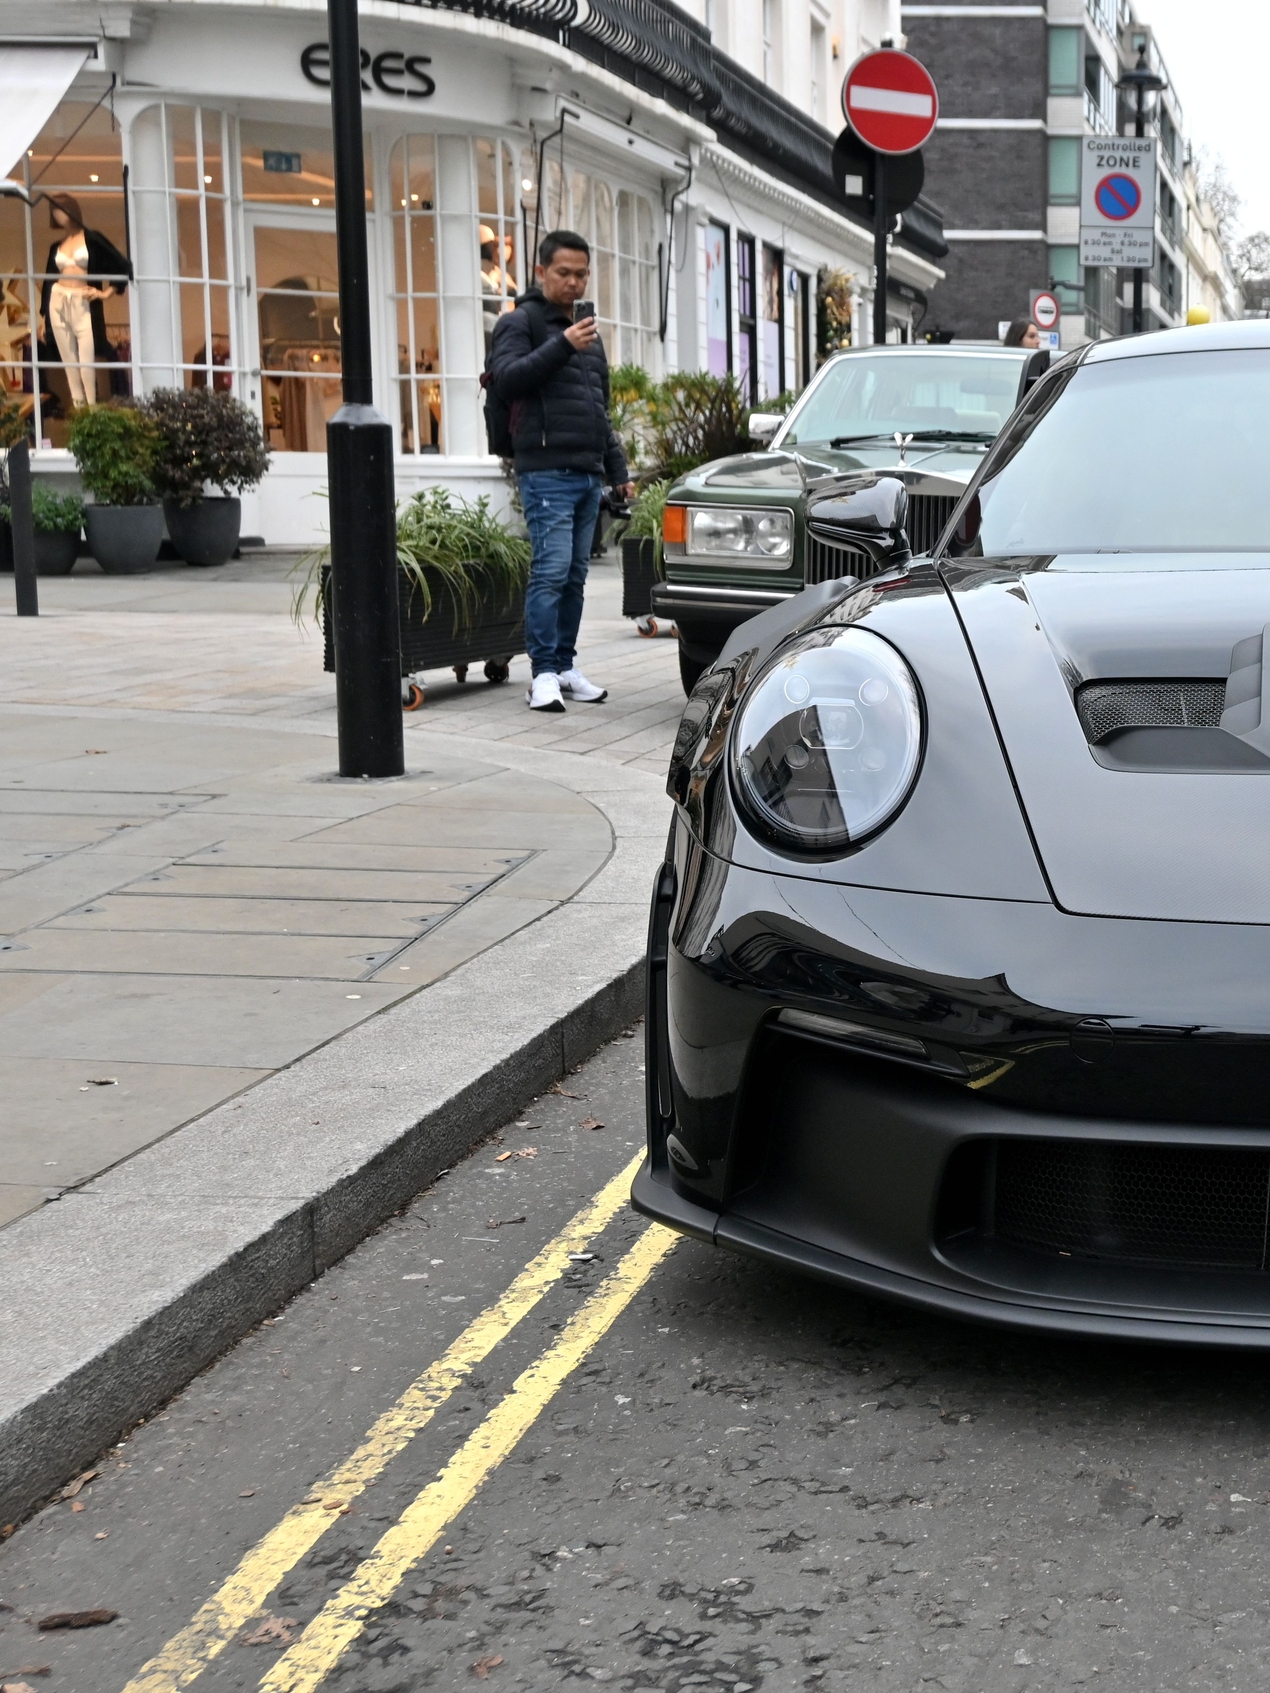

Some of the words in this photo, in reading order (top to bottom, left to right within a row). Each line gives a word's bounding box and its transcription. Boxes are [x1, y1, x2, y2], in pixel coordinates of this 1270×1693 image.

[1087, 140, 1151, 152] Controlled
[1096, 154, 1141, 168] ZONE
[1123, 231, 1134, 239] Fri
